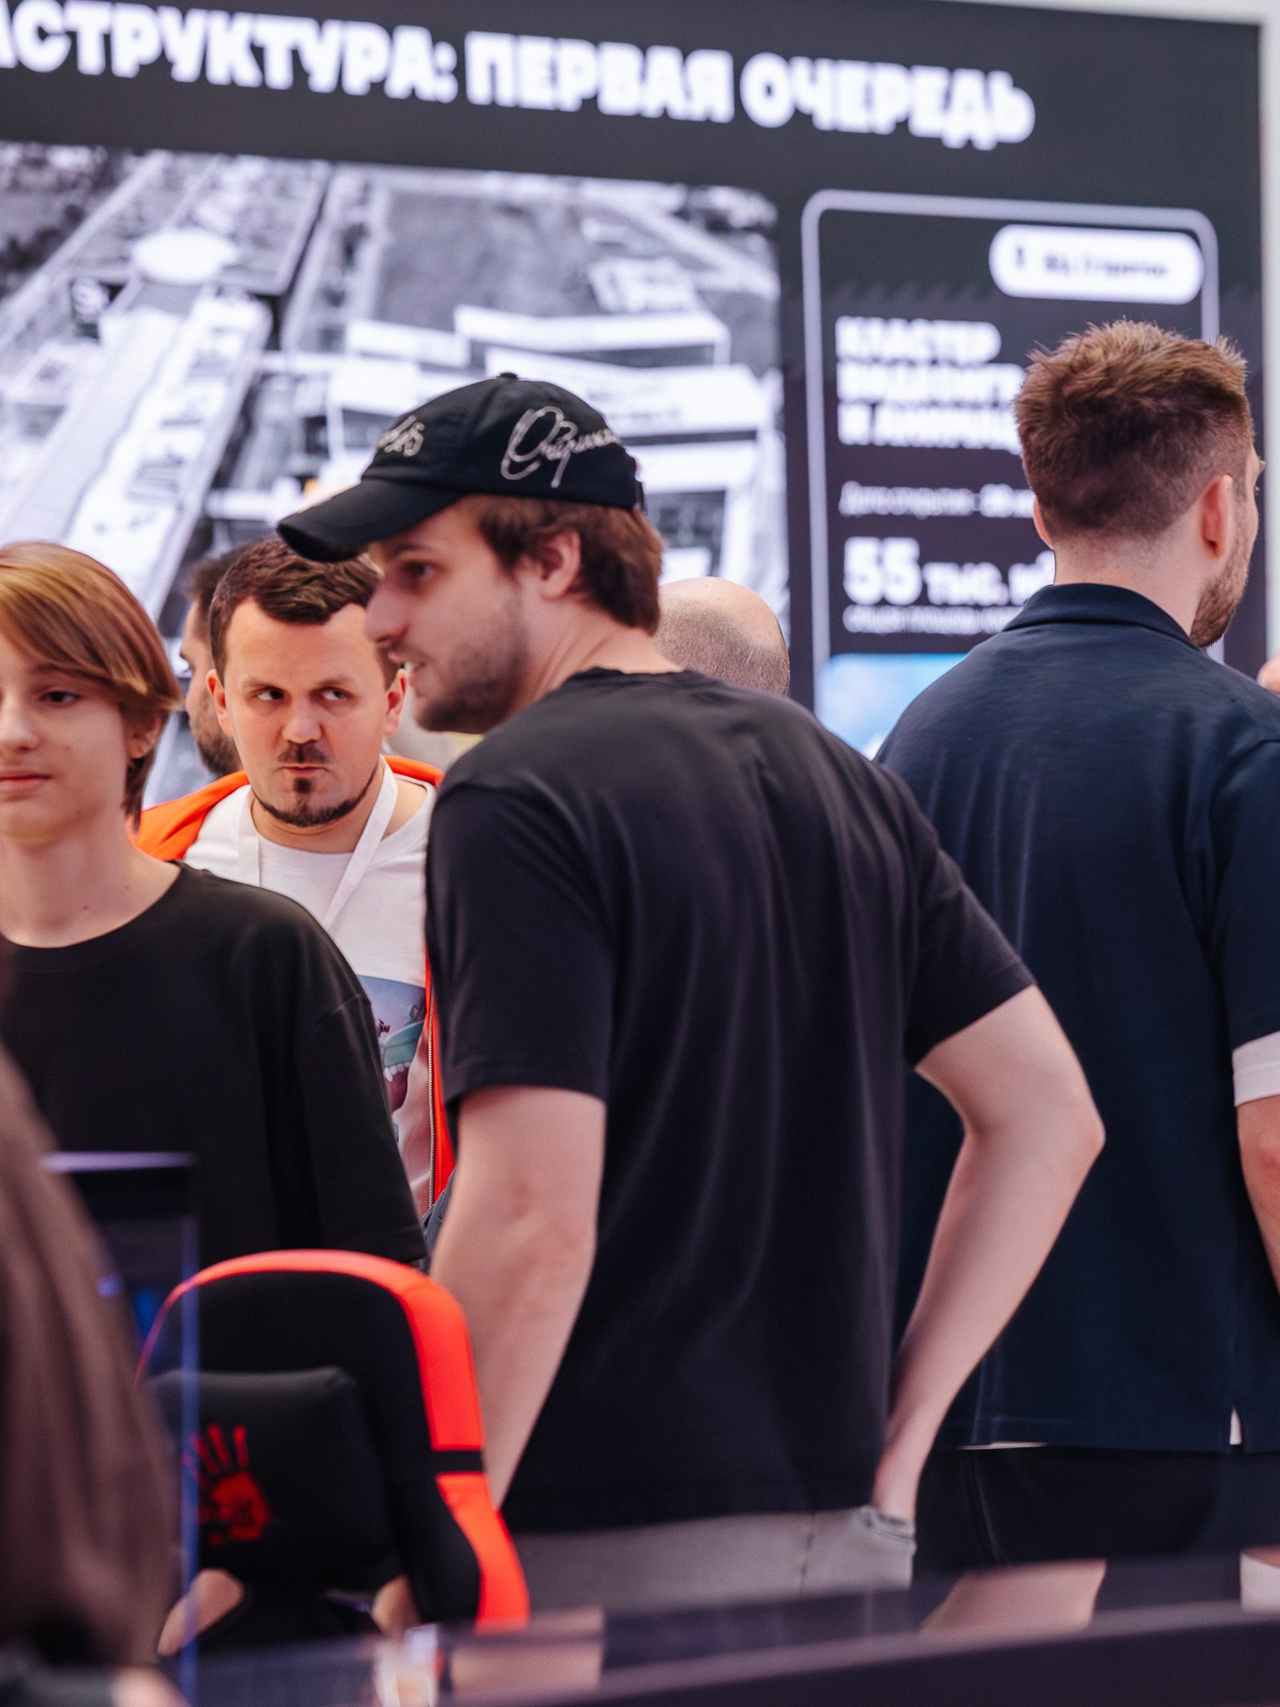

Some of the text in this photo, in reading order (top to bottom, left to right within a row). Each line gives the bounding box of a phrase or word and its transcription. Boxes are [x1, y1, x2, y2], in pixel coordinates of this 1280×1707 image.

[465, 31, 735, 123] ПЕРВАЯ
[740, 53, 1036, 151] ОЧЕРЕДЬ
[844, 537, 922, 605] 55
